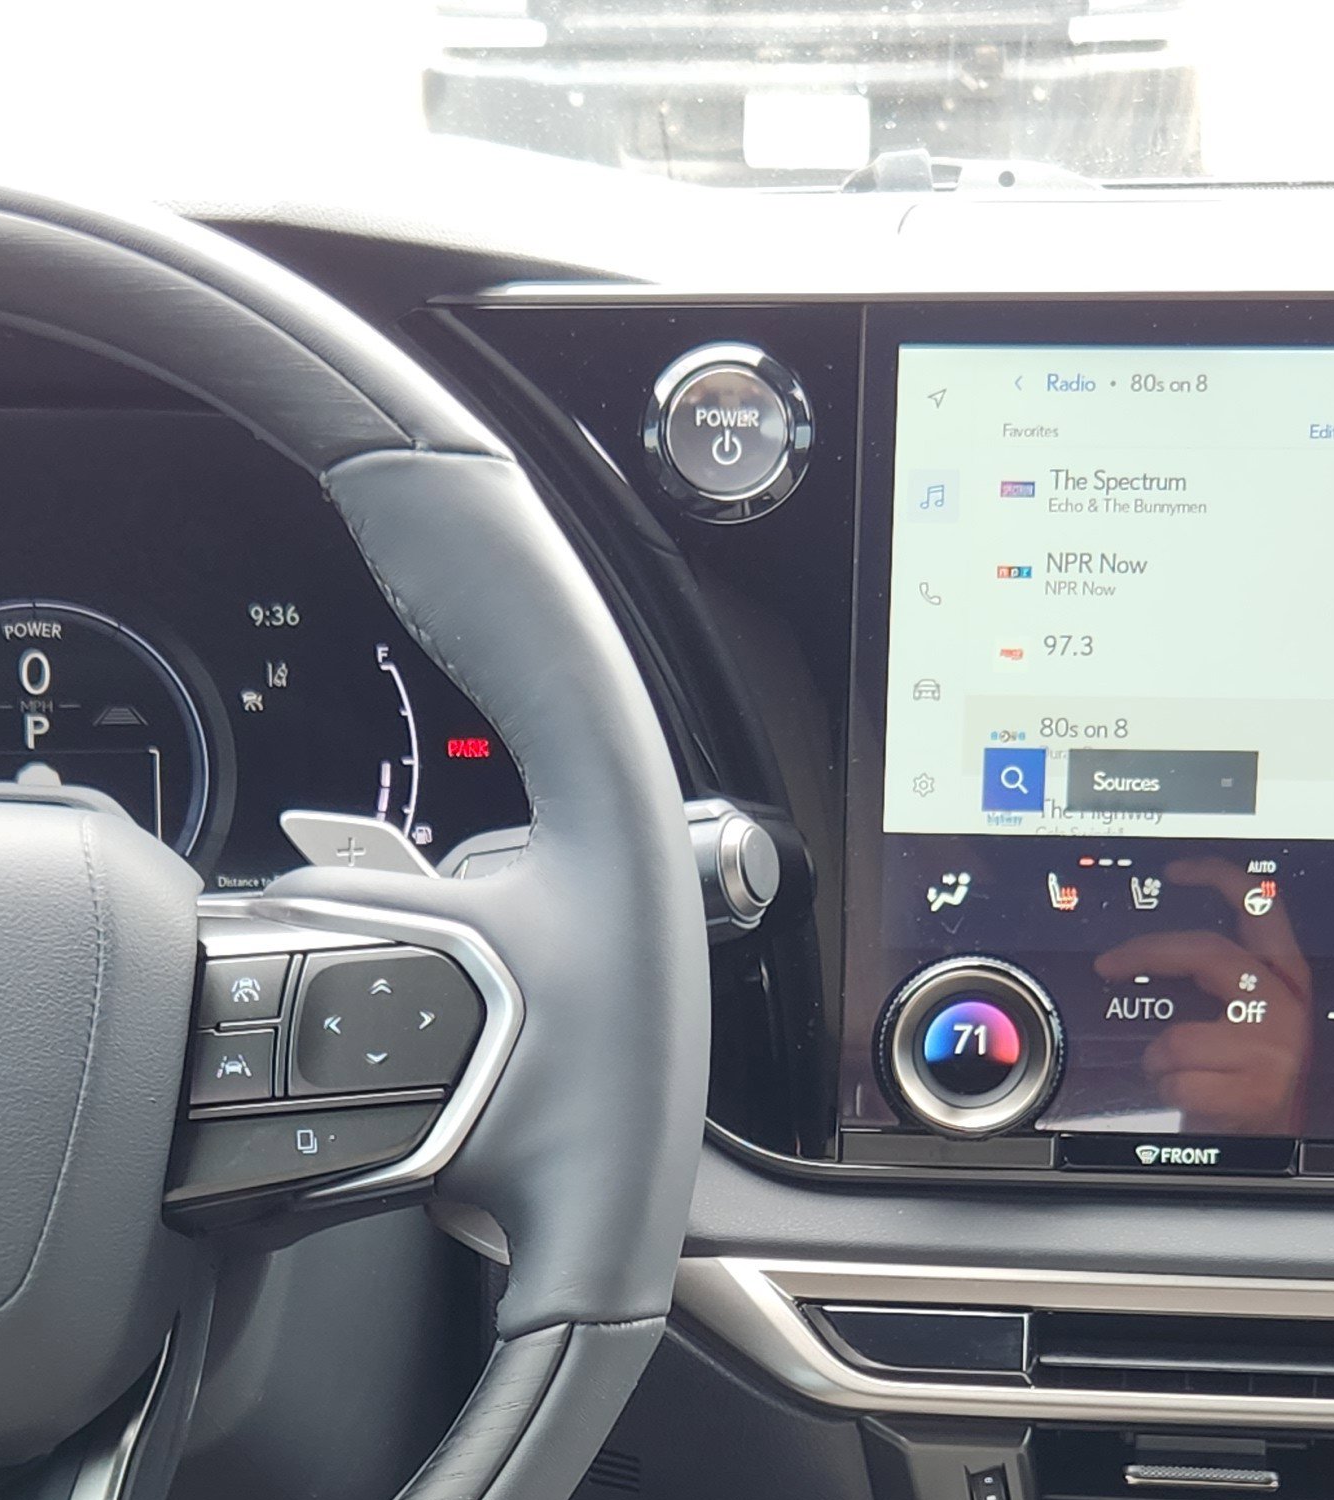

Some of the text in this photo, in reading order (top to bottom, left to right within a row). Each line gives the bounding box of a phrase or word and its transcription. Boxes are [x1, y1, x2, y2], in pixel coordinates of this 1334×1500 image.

[1047, 373, 1208, 393] Radio 80s on 8
[695, 409, 760, 427] POWER
[1002, 423, 1059, 439] Favorites
[1049, 469, 1088, 491] The
[1093, 469, 1187, 496] Spectrum
[1048, 498, 1207, 517] Echo & The Bunnymen
[1046, 552, 1148, 575] NPR Now
[1044, 580, 1116, 597] NPR Now
[250, 606, 300, 627] 9:36
[4, 622, 62, 640] POWER
[1044, 635, 1094, 657] 97.3
[25, 714, 50, 750] P
[1040, 718, 1078, 739] 80s
[1084, 724, 1111, 739] on
[1114, 718, 1129, 739] 8
[447, 738, 490, 758] PARK
[1093, 770, 1161, 792] Sources
[1247, 860, 1277, 874] AUTO
[218, 875, 260, 888] Distance
[1106, 997, 1174, 1020] AUTO
[1227, 1000, 1267, 1023] Off
[953, 1025, 988, 1057] 71
[1161, 1148, 1220, 1165] FRONT
